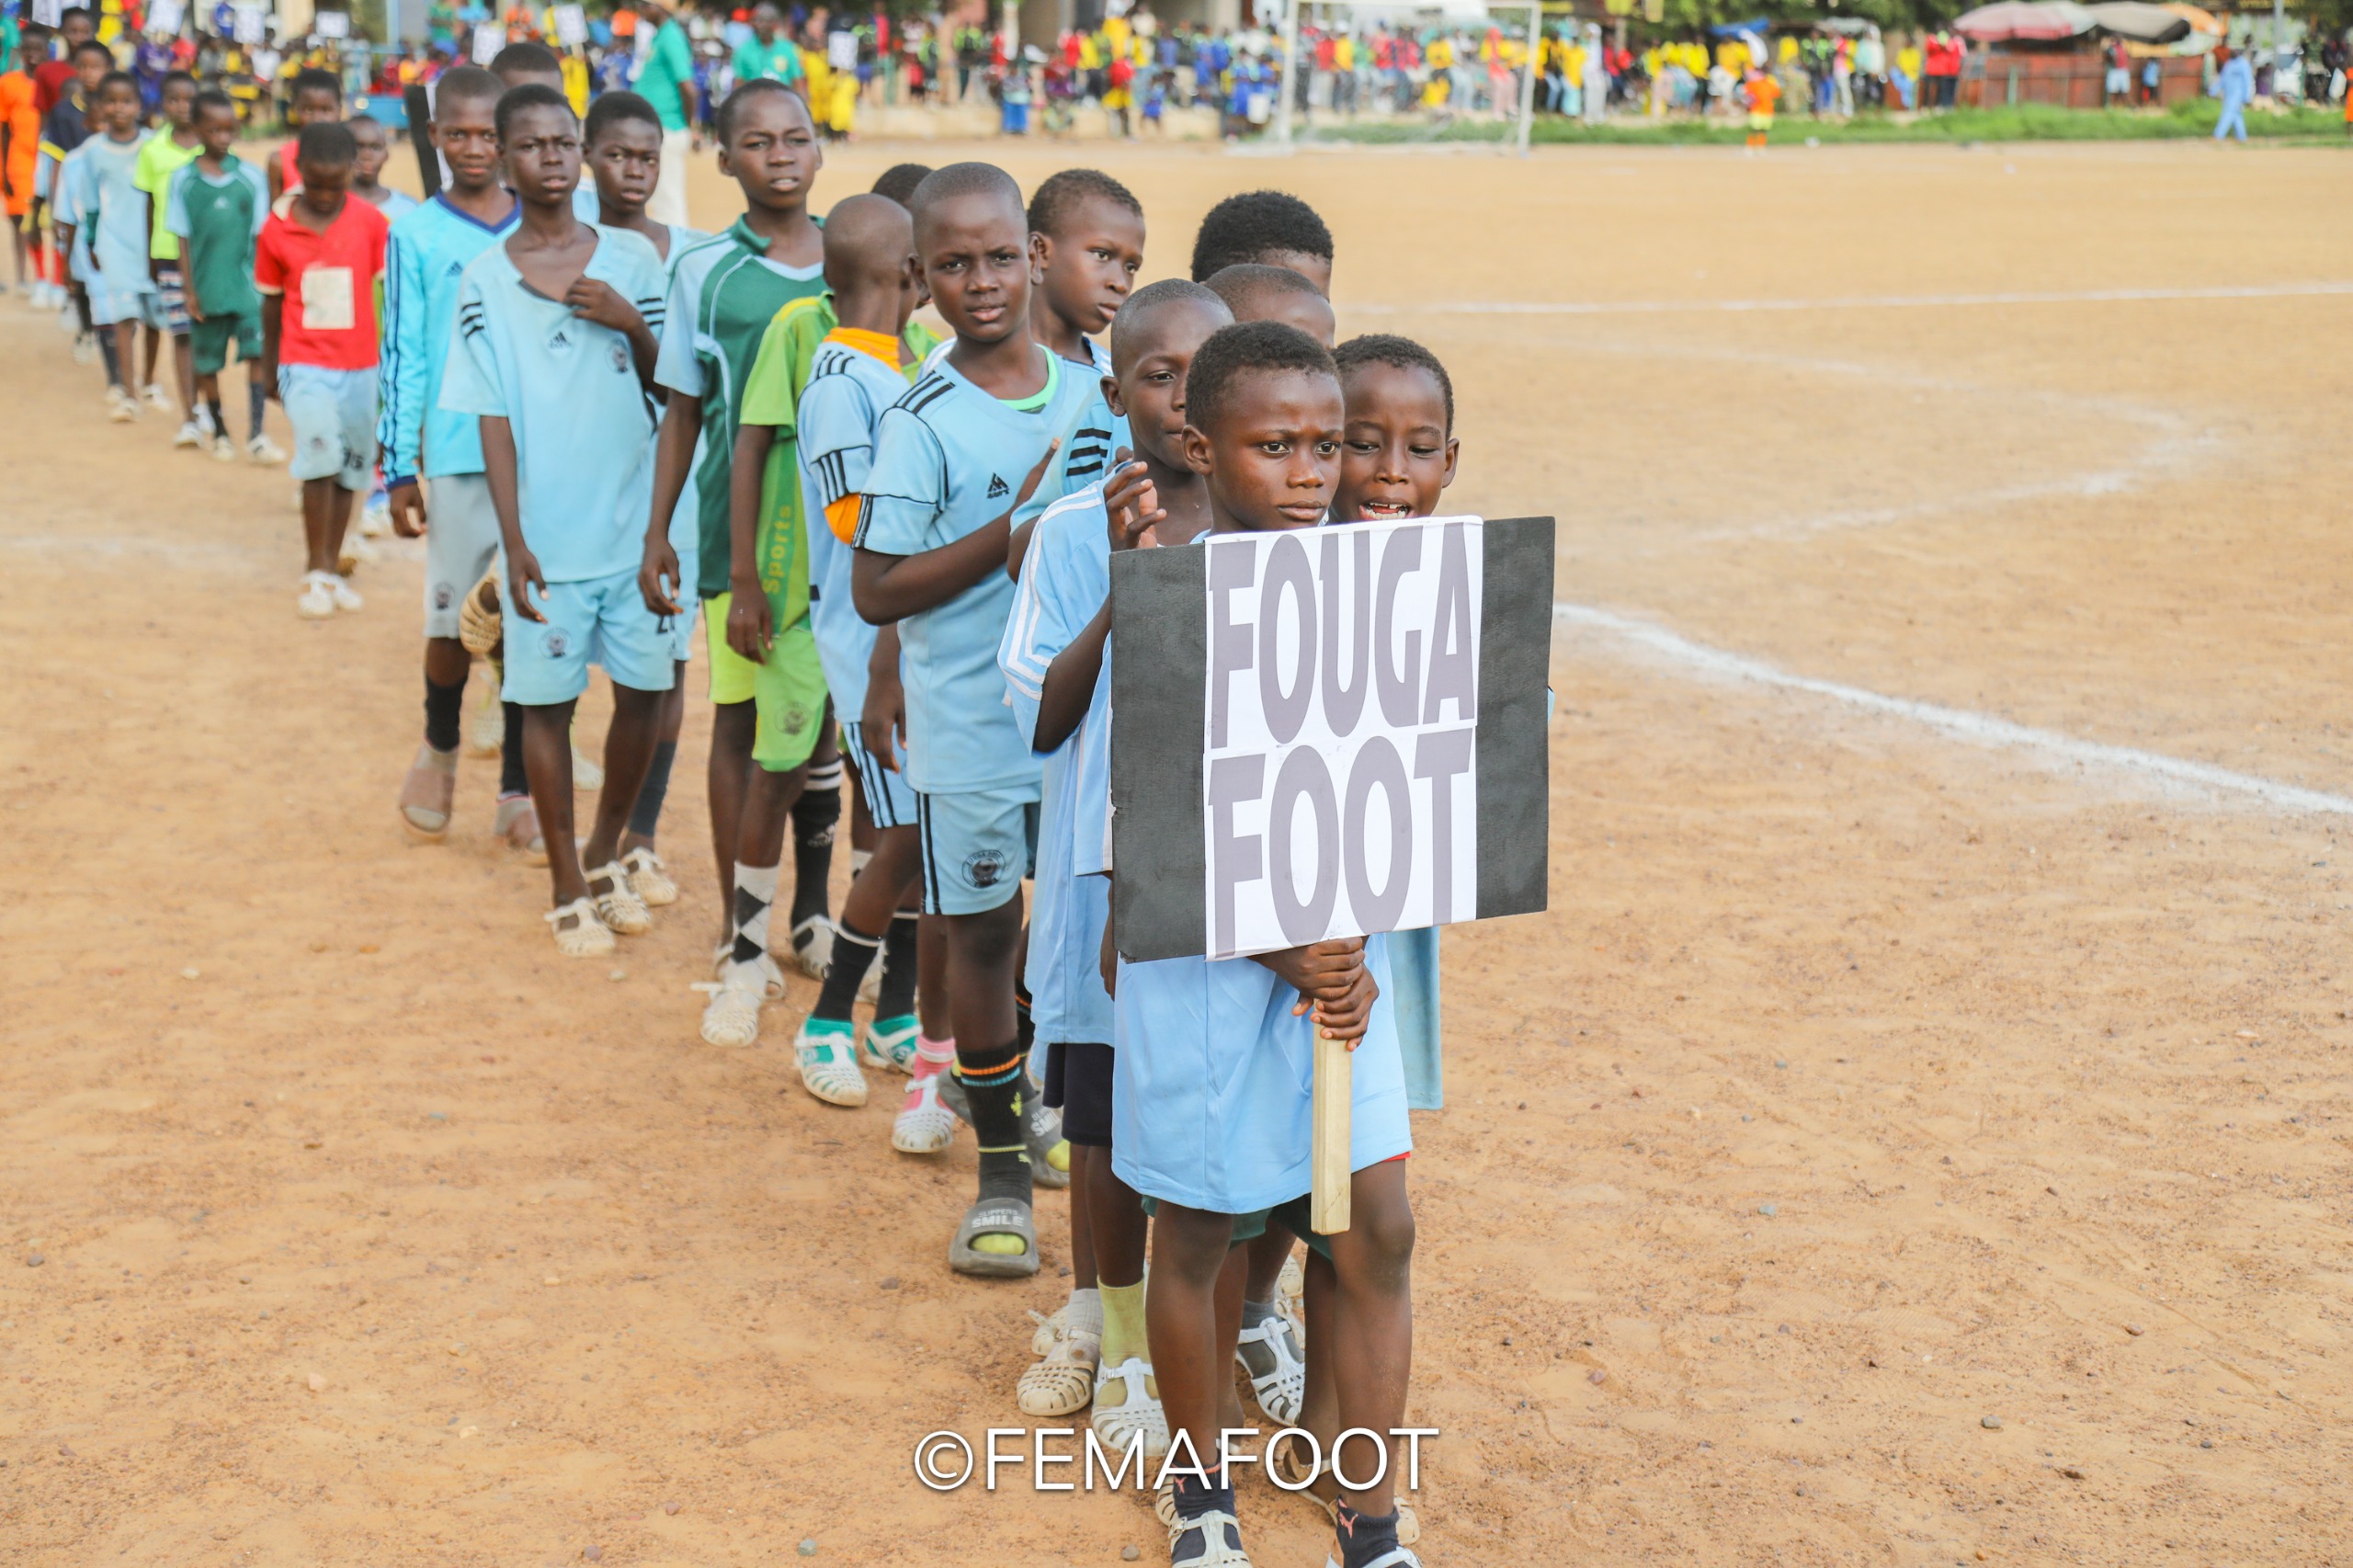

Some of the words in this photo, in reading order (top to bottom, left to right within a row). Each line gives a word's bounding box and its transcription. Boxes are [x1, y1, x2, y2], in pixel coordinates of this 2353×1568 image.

[762, 505, 791, 596] Sports
[1209, 522, 1475, 749] FOUGA
[1208, 727, 1473, 959] FOOT
[972, 1215, 1025, 1228] SMILE
